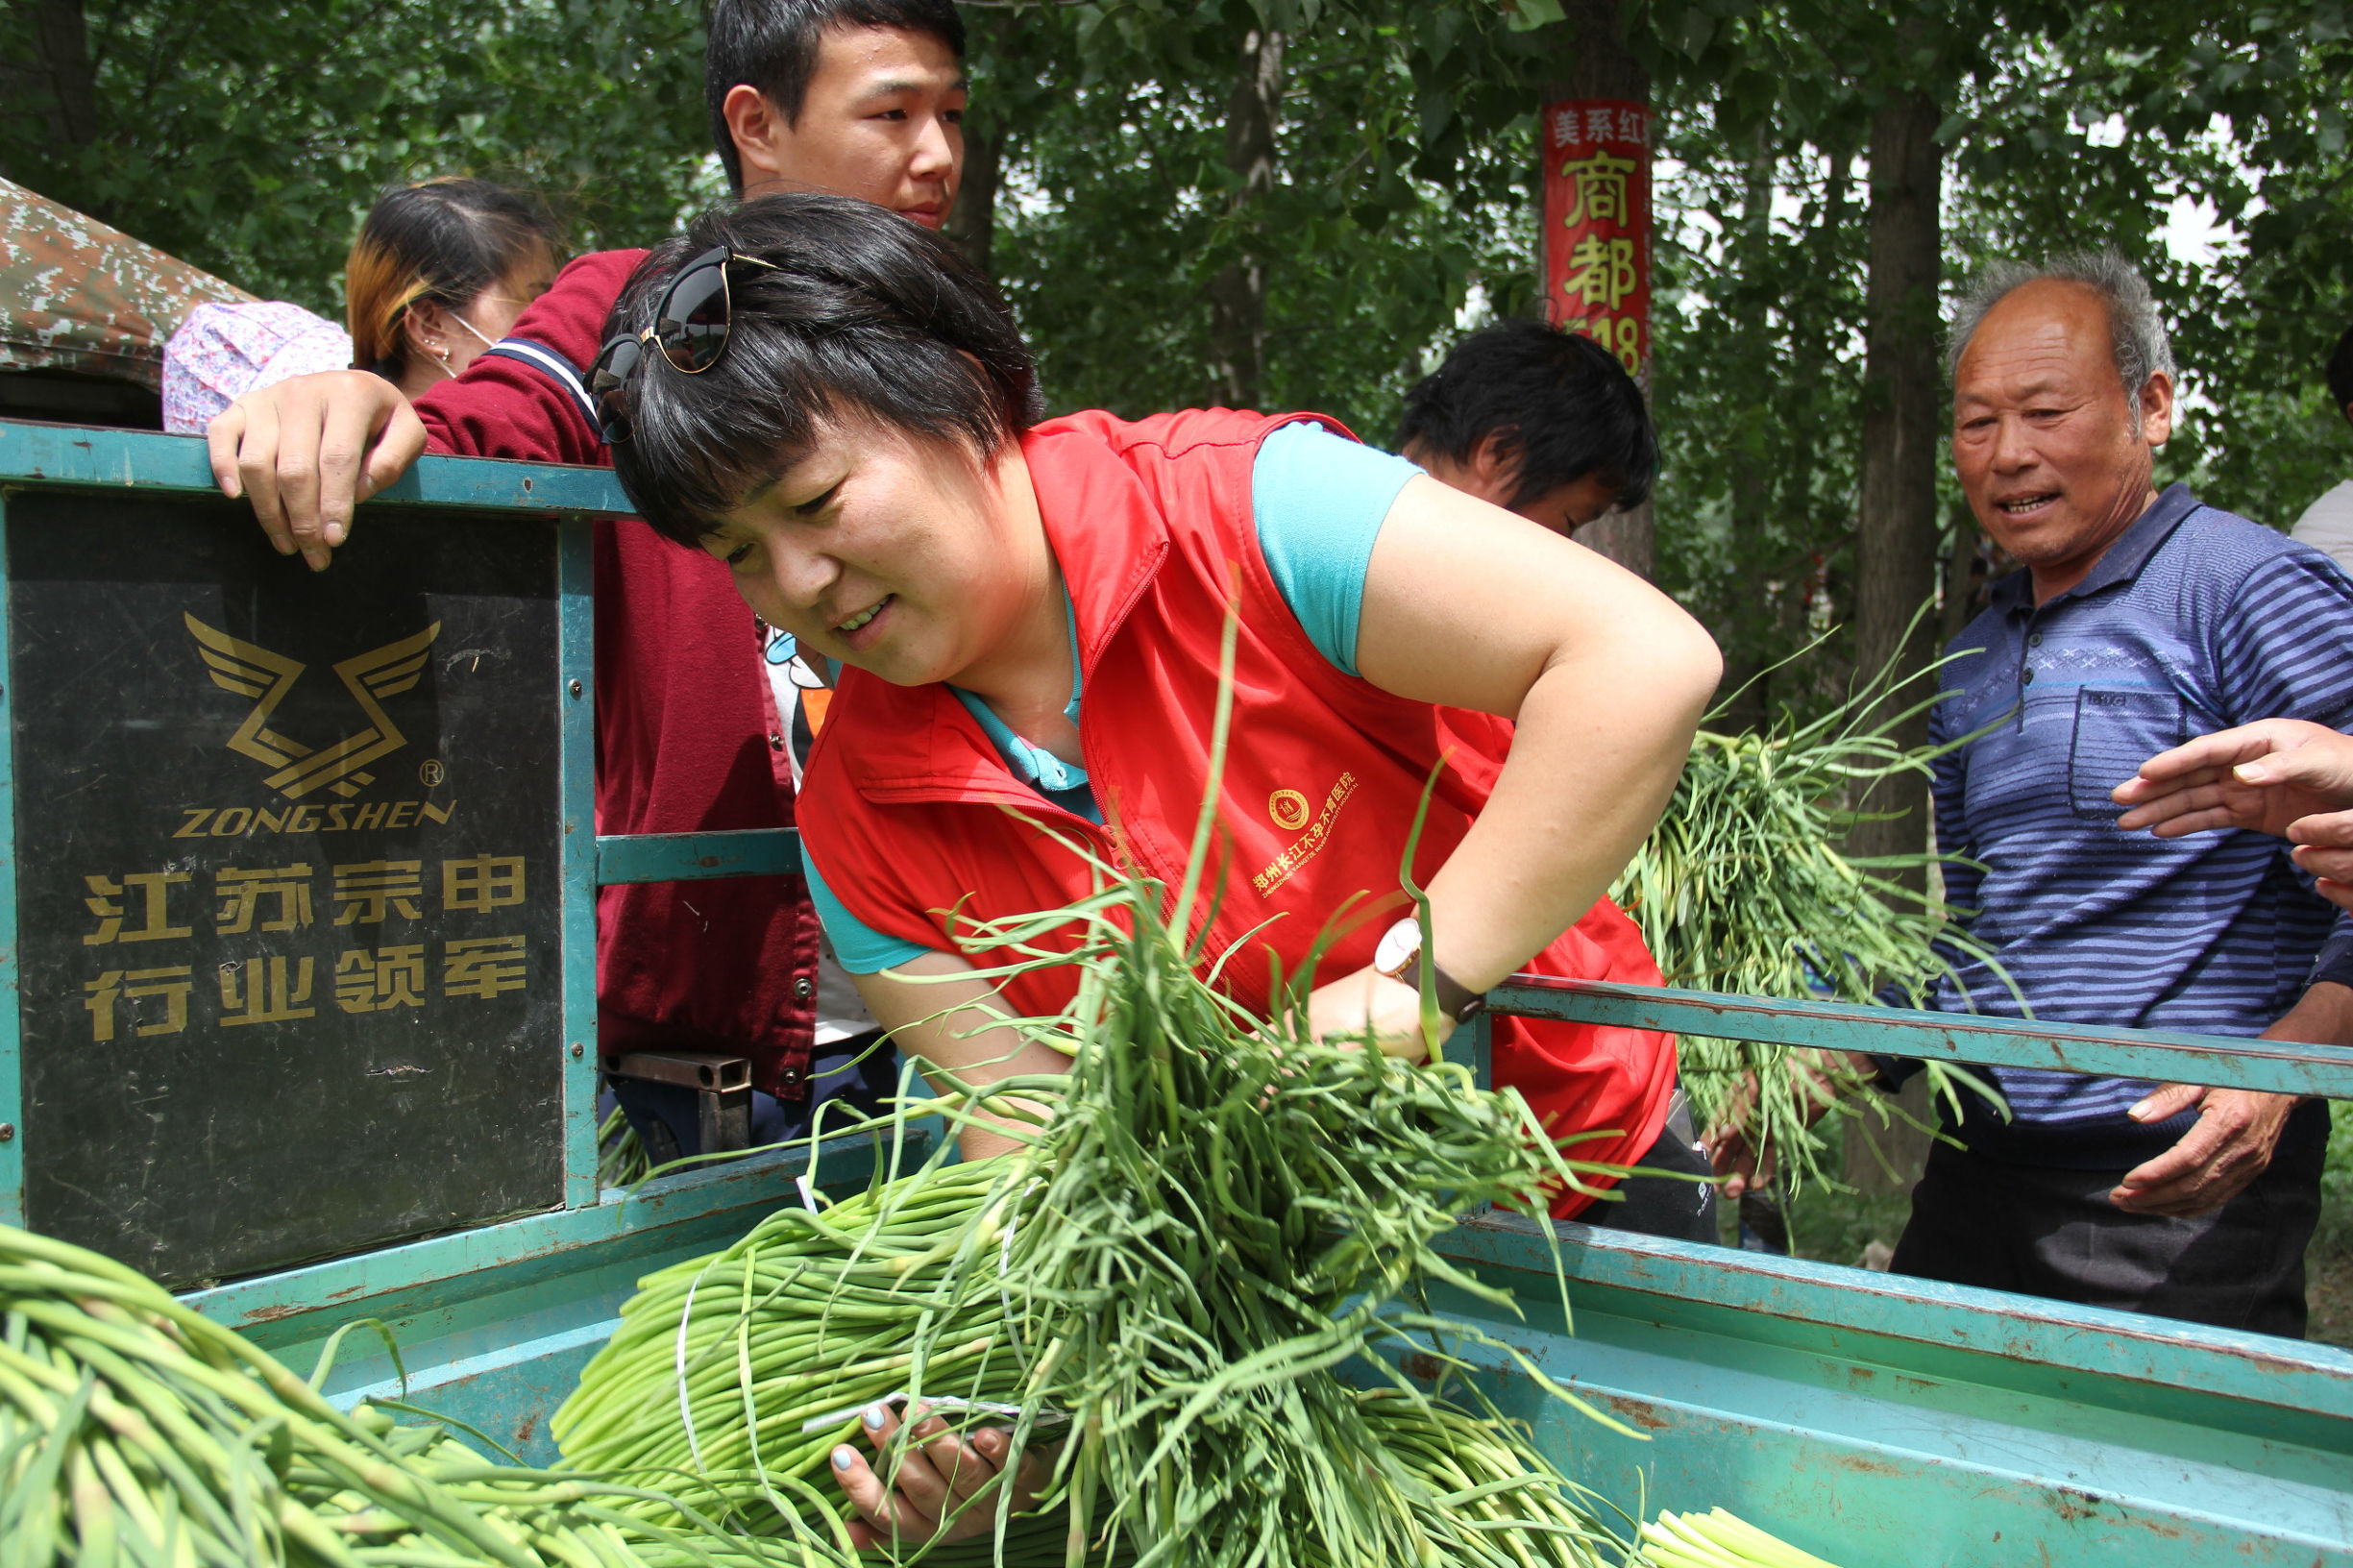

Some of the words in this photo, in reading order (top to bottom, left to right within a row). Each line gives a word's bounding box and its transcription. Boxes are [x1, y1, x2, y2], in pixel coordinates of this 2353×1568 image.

[1554, 108, 1651, 148] 美系红
[172, 799, 457, 839] ZONGSHEN
[1253, 772, 1356, 892] 郑州长江不孕不育医院
[83, 853, 527, 945] 江苏宗申
[1262, 870, 1293, 898] ZHENGZHOU
[83, 935, 527, 1041] 行业领军
